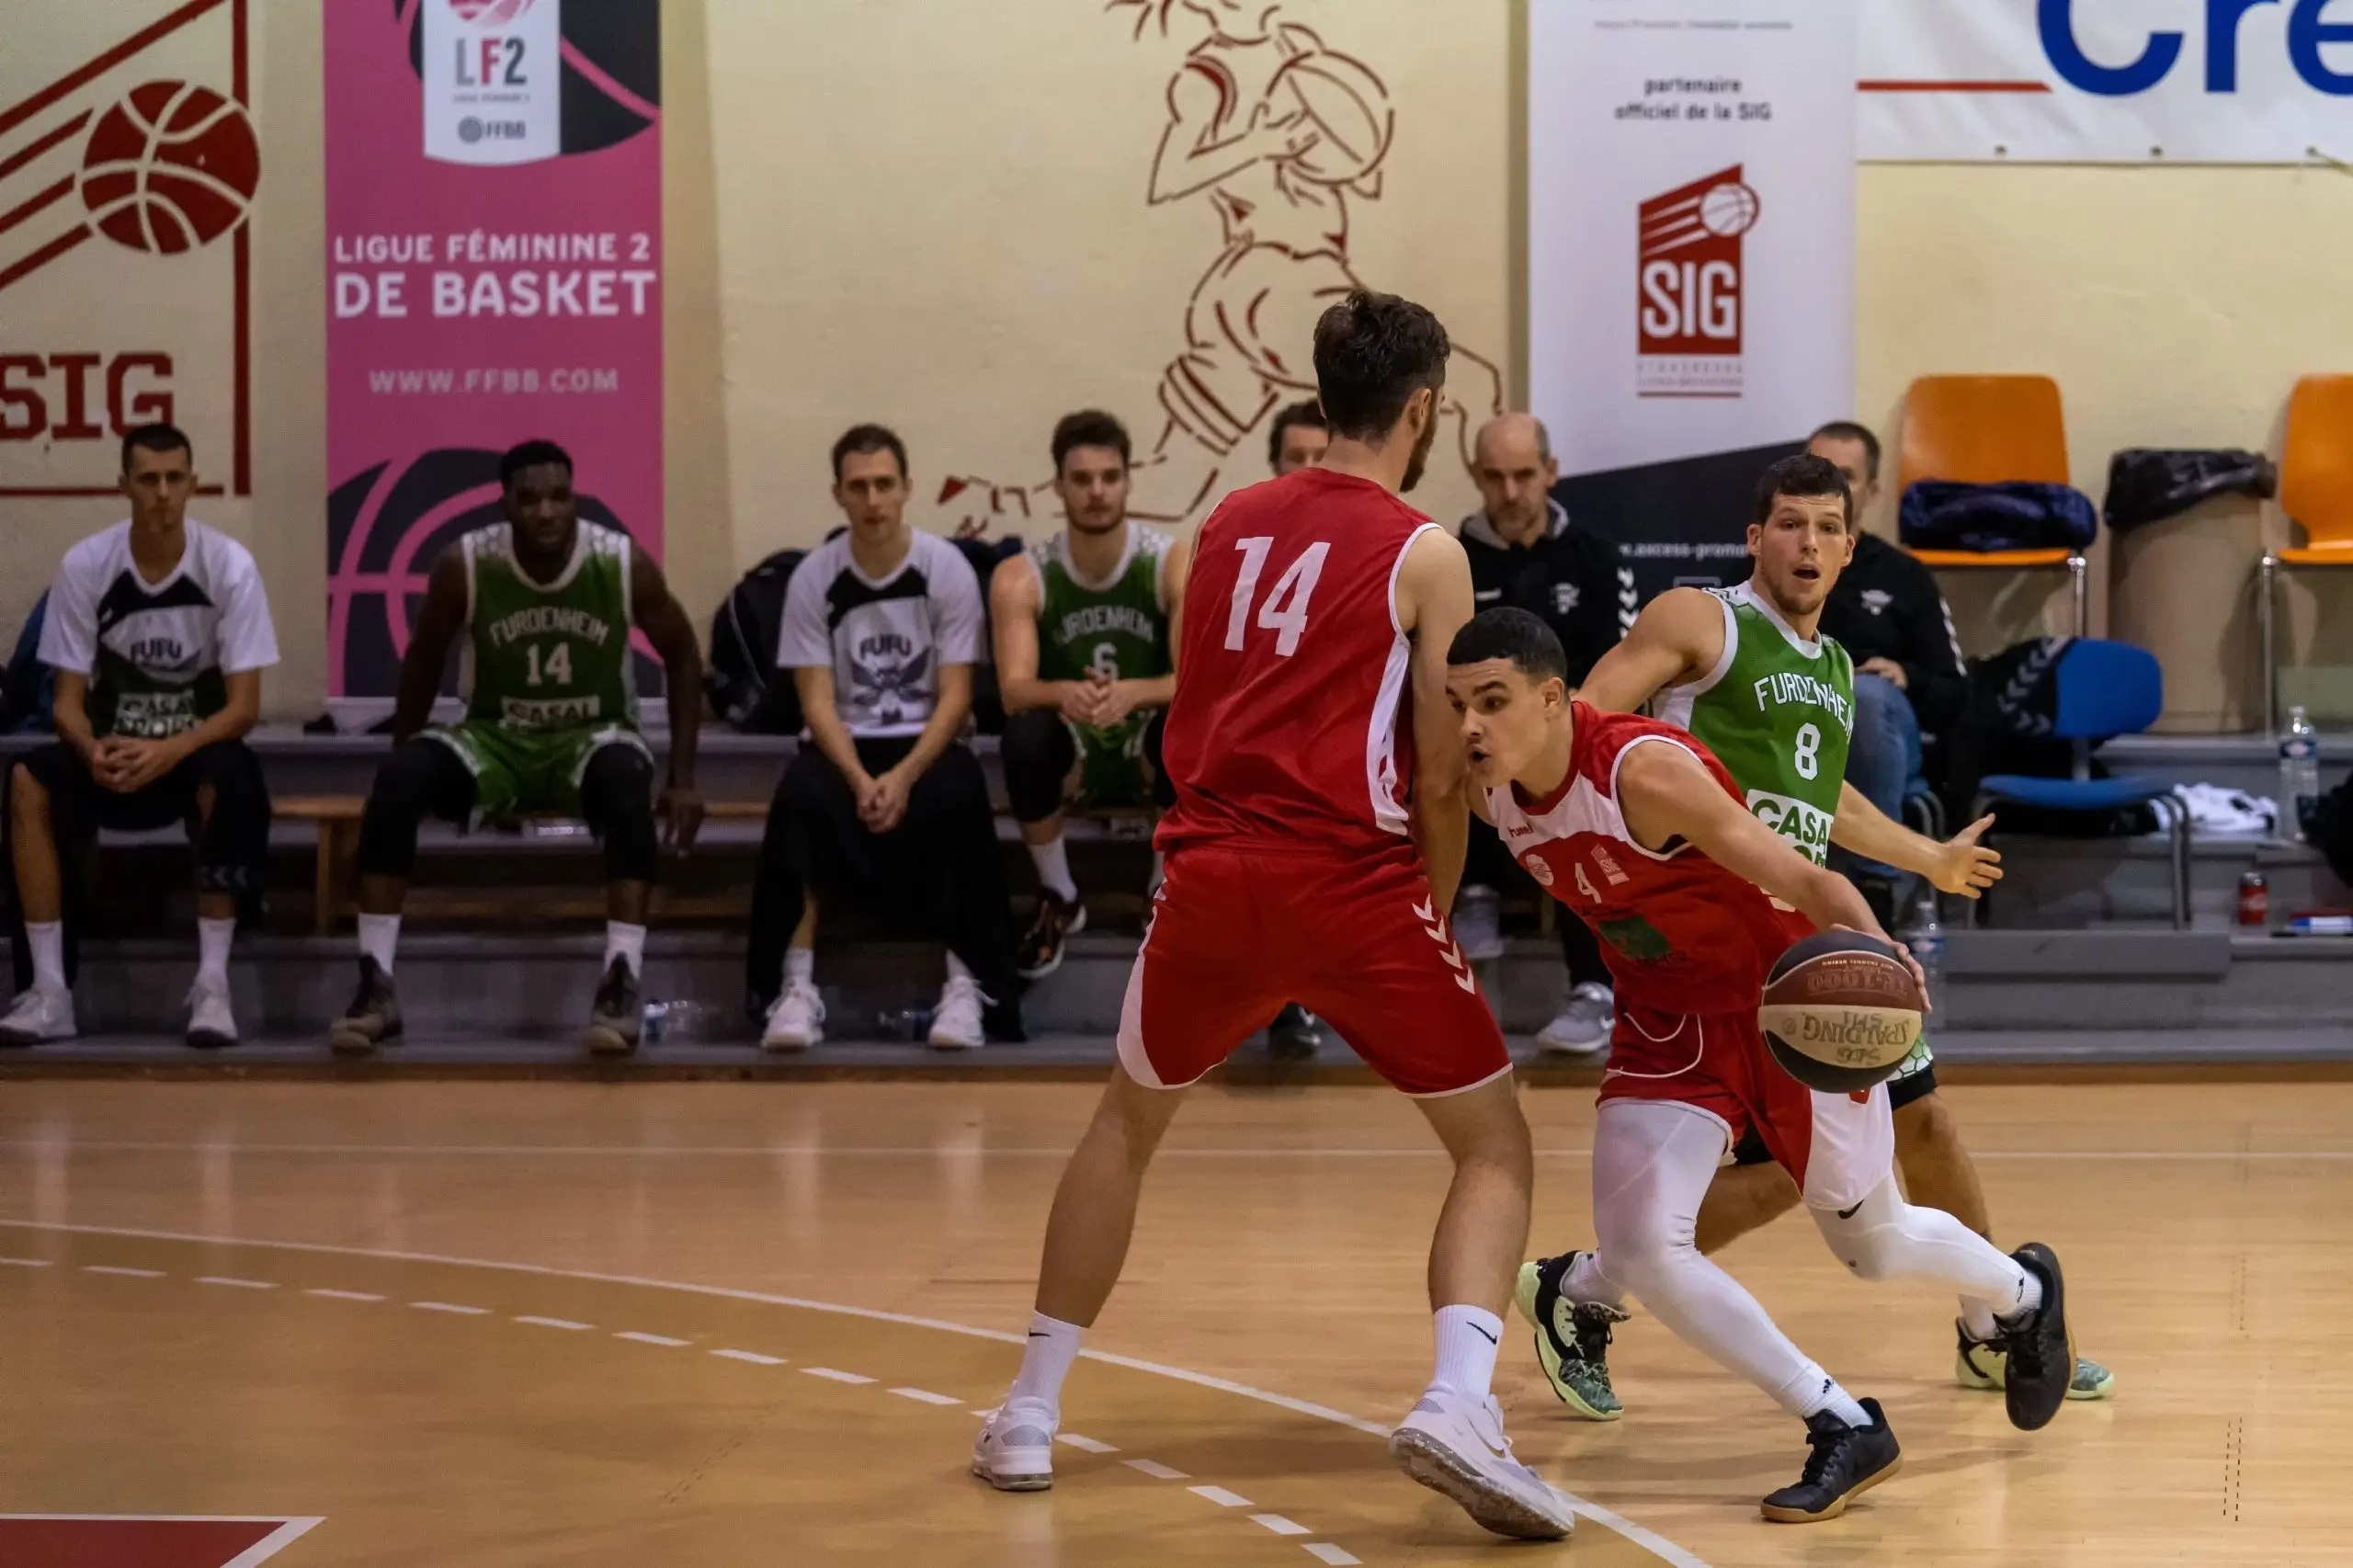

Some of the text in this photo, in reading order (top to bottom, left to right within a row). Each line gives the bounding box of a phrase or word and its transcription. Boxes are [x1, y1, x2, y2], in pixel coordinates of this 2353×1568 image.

[455, 36, 528, 86] LF2
[1643, 75, 1743, 97] partenaire
[1614, 100, 1772, 120] officiel de la SIG
[334, 228, 651, 264] LIGUE FÉMININE 2
[335, 269, 657, 318] DE BASKET
[1642, 259, 1737, 339] SIG
[0, 352, 174, 440] SIG
[1223, 536, 1332, 657] 14
[488, 605, 610, 648] FURDENHEIM
[526, 641, 573, 687] 14
[1092, 642, 1120, 683] 6
[1794, 722, 1822, 781] 8
[1574, 862, 1603, 904] 4
[1802, 1012, 1910, 1046] SPALDING
